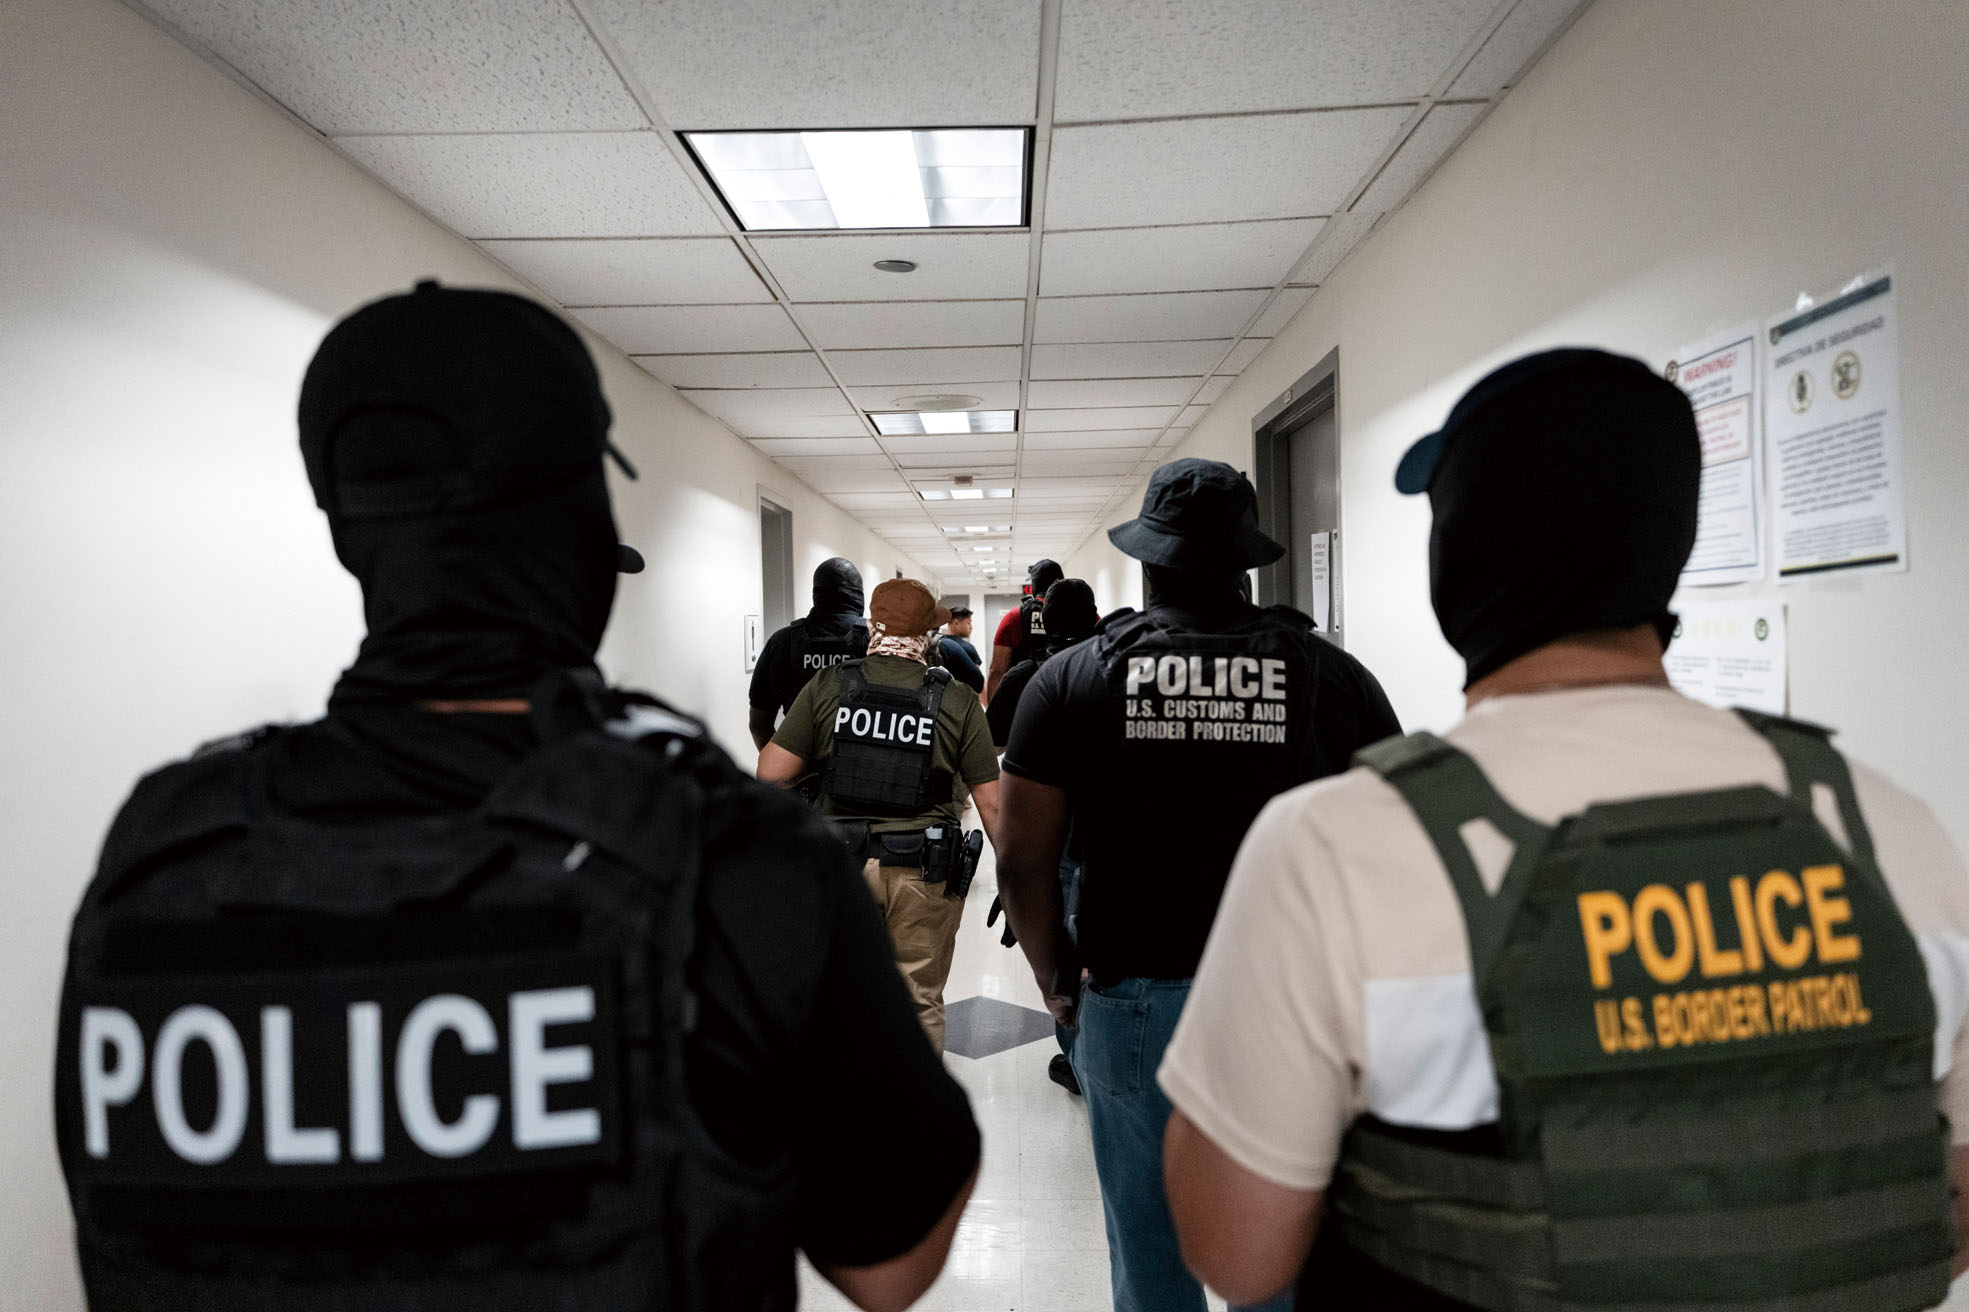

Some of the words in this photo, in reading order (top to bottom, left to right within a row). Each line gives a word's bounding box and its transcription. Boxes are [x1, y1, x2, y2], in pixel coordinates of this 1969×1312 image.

[1684, 352, 1737, 383] WARNING!
[1126, 655, 1287, 700] POLICE
[834, 707, 933, 746] POLICE
[1126, 699, 1157, 718] U.S.
[1163, 699, 1246, 720] CUSTOMS
[1252, 702, 1287, 722] AND
[1125, 720, 1187, 740] BORDER
[1192, 721, 1287, 744] PROTECTION
[1577, 863, 1862, 990] POLICE
[1594, 996, 1652, 1054] U.S.
[1652, 984, 1773, 1050] BORDER
[1767, 973, 1872, 1035] PATROL
[79, 986, 601, 1166] POLICE
